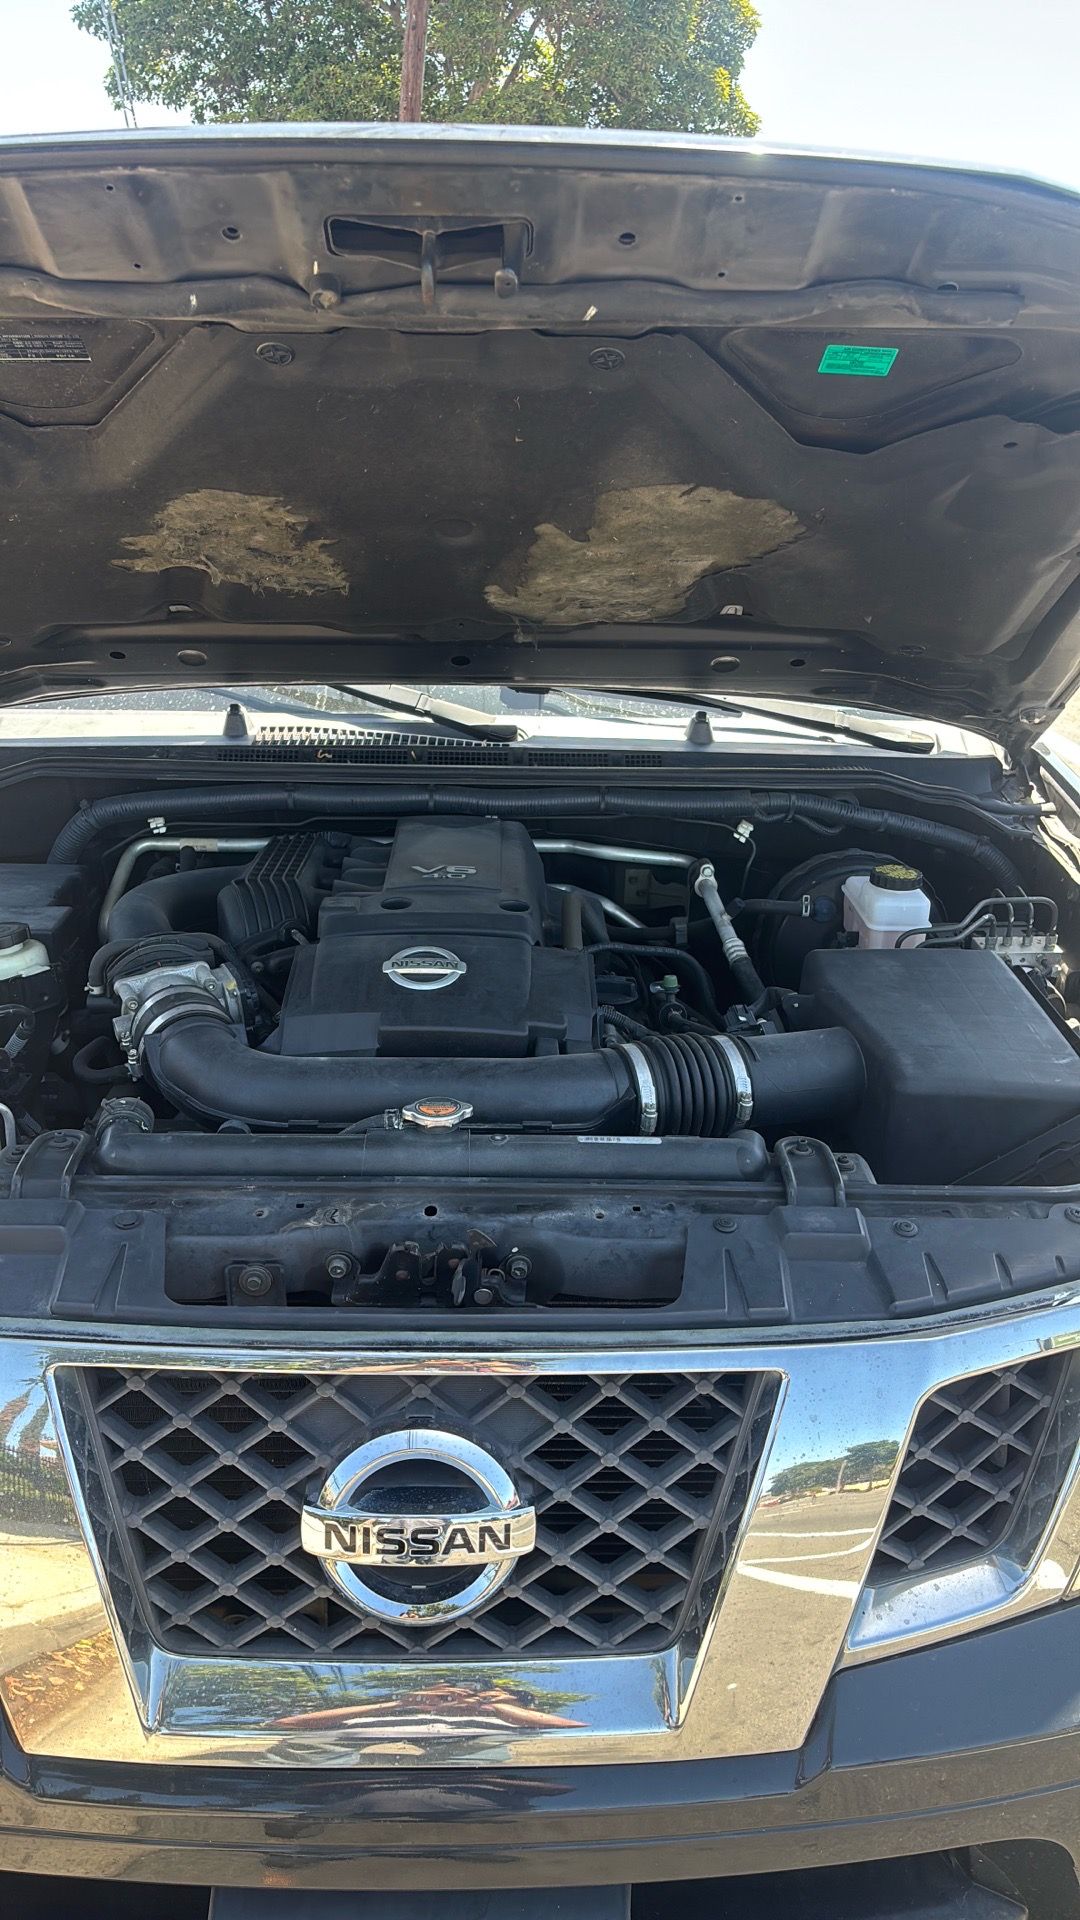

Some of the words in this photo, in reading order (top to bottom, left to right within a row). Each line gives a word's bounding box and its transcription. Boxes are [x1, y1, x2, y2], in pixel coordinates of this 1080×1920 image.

[411, 865, 477, 874] V6
[391, 960, 459, 969] NISSAN
[323, 1522, 512, 1556] NISSAN
